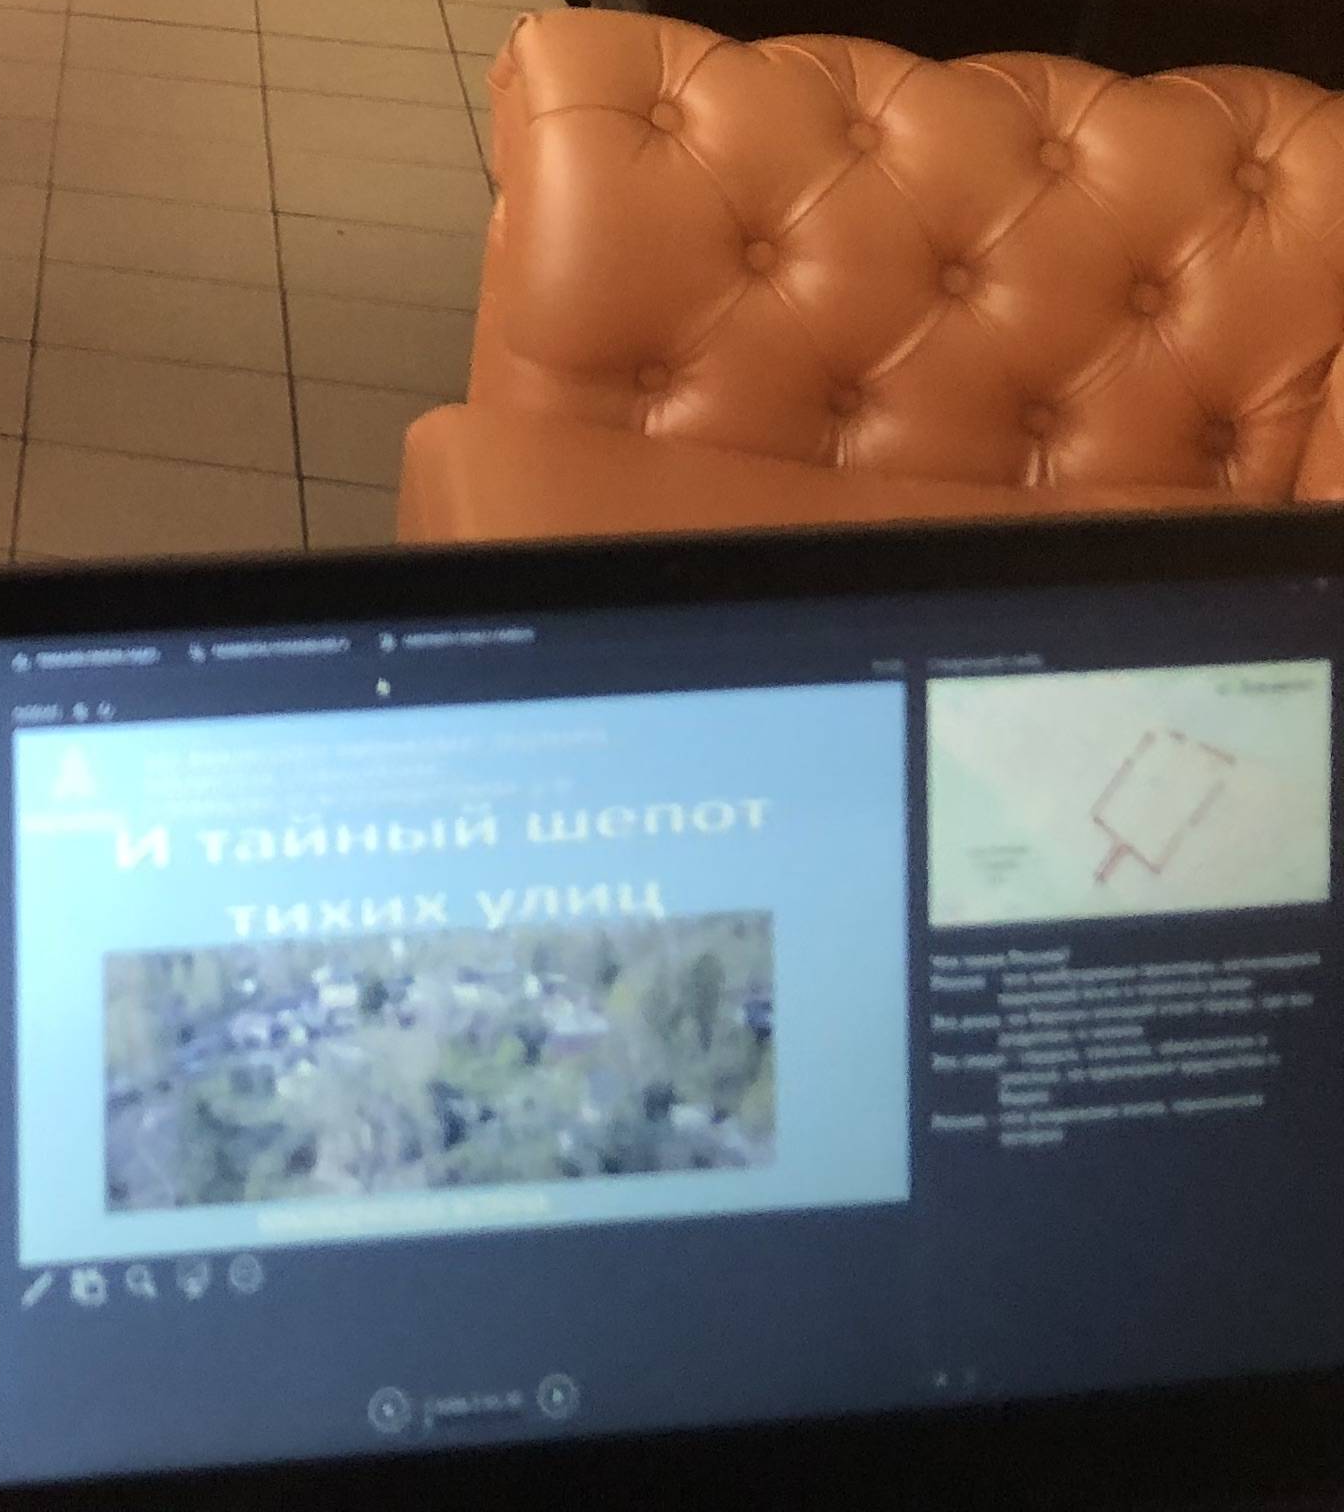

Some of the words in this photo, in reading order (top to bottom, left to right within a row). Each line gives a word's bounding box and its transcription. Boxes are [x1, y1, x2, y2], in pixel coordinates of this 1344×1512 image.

[116, 824, 170, 869] И
[198, 801, 498, 864] тайный
[525, 795, 772, 843] шепот
[225, 895, 448, 938] тихих
[474, 880, 668, 929] улиц
